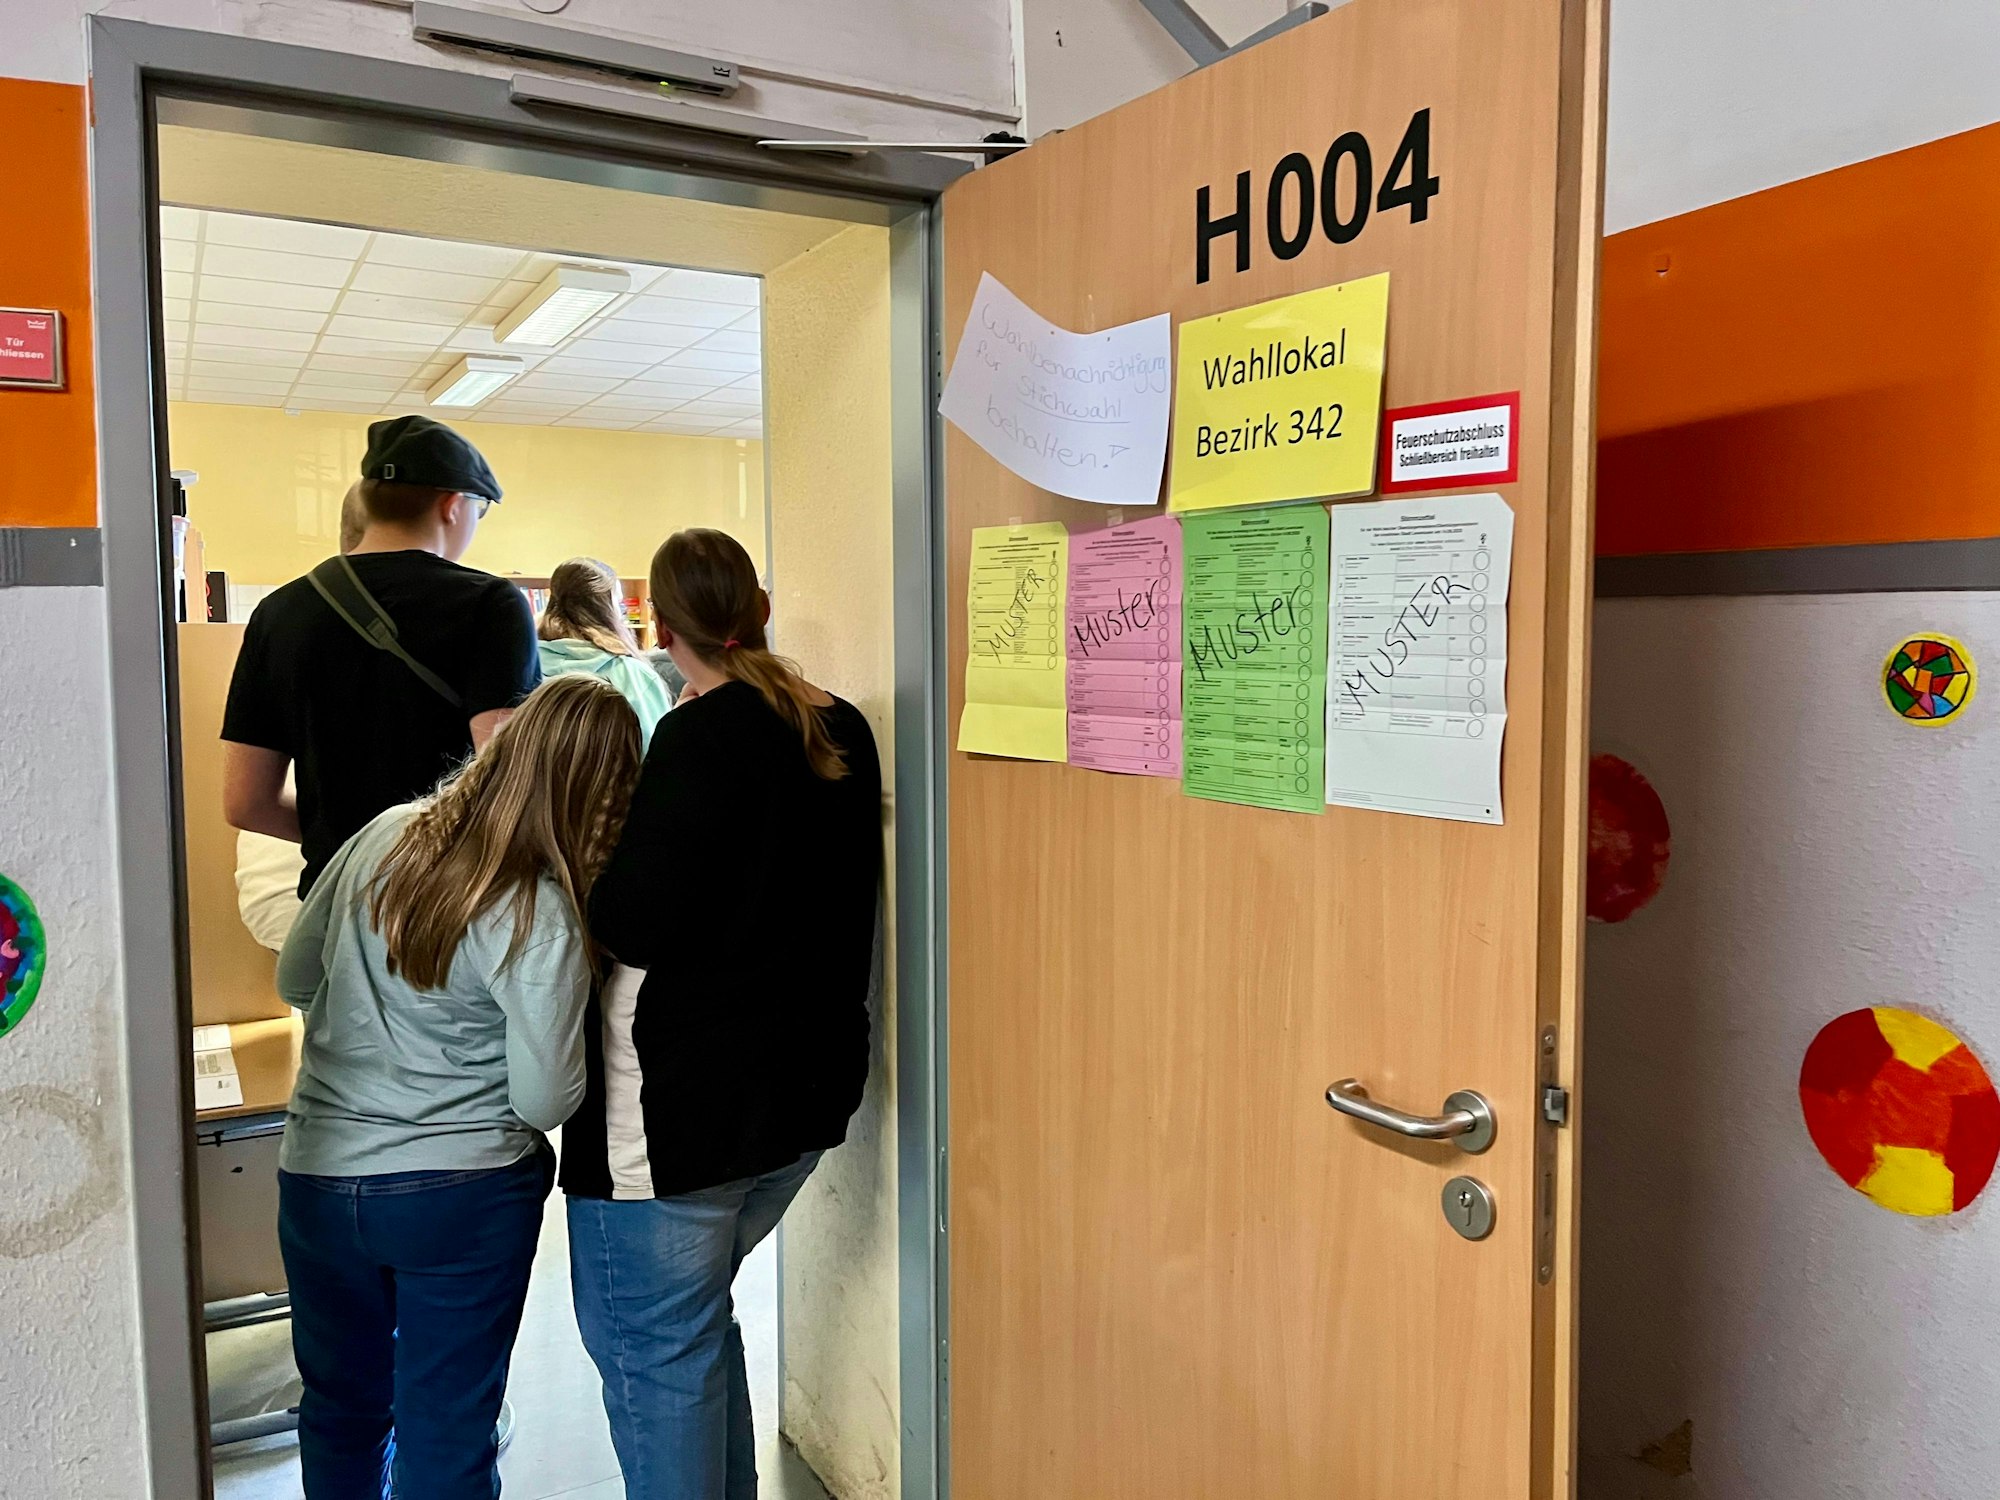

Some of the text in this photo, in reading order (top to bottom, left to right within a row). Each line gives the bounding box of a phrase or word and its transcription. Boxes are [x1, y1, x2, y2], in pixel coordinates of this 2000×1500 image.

[1197, 107, 1439, 284] H004
[0, 348, 45, 359] hliessen
[5, 336, 24, 347] Tür
[1203, 328, 1346, 390] Wahllokal
[1016, 375, 1122, 418] Stichwahl
[1196, 403, 1343, 458] Bezirk 342
[1396, 423, 1505, 450] Feuerschutzabschluss
[1399, 444, 1500, 467] Schließbereich freihalten
[988, 568, 1045, 665] MUSTER
[1345, 575, 1471, 713] MUSTER
